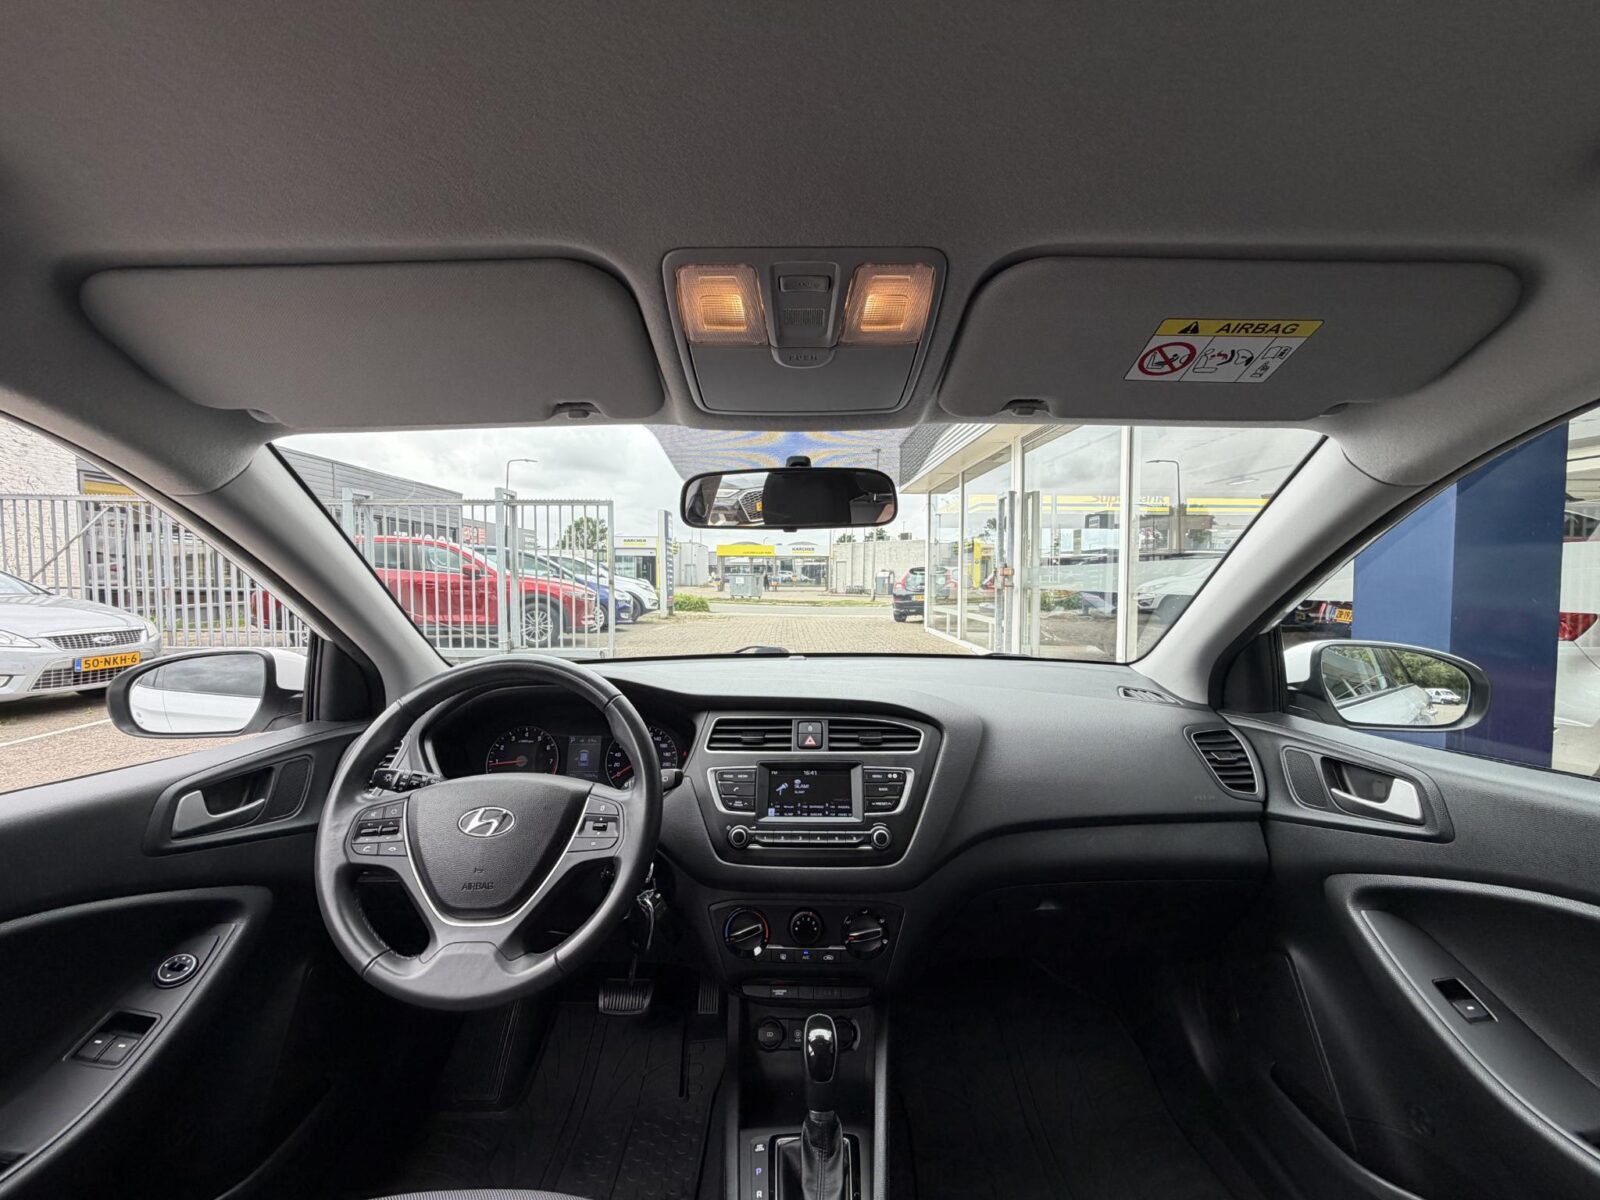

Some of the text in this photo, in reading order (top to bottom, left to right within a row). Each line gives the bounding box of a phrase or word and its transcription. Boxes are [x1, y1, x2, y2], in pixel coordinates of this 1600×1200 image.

[1215, 323, 1300, 335] AIRBAG
[84, 655, 137, 669] 50-NKH-6
[460, 881, 495, 891] AIRBAG
[756, 1167, 762, 1176] P
